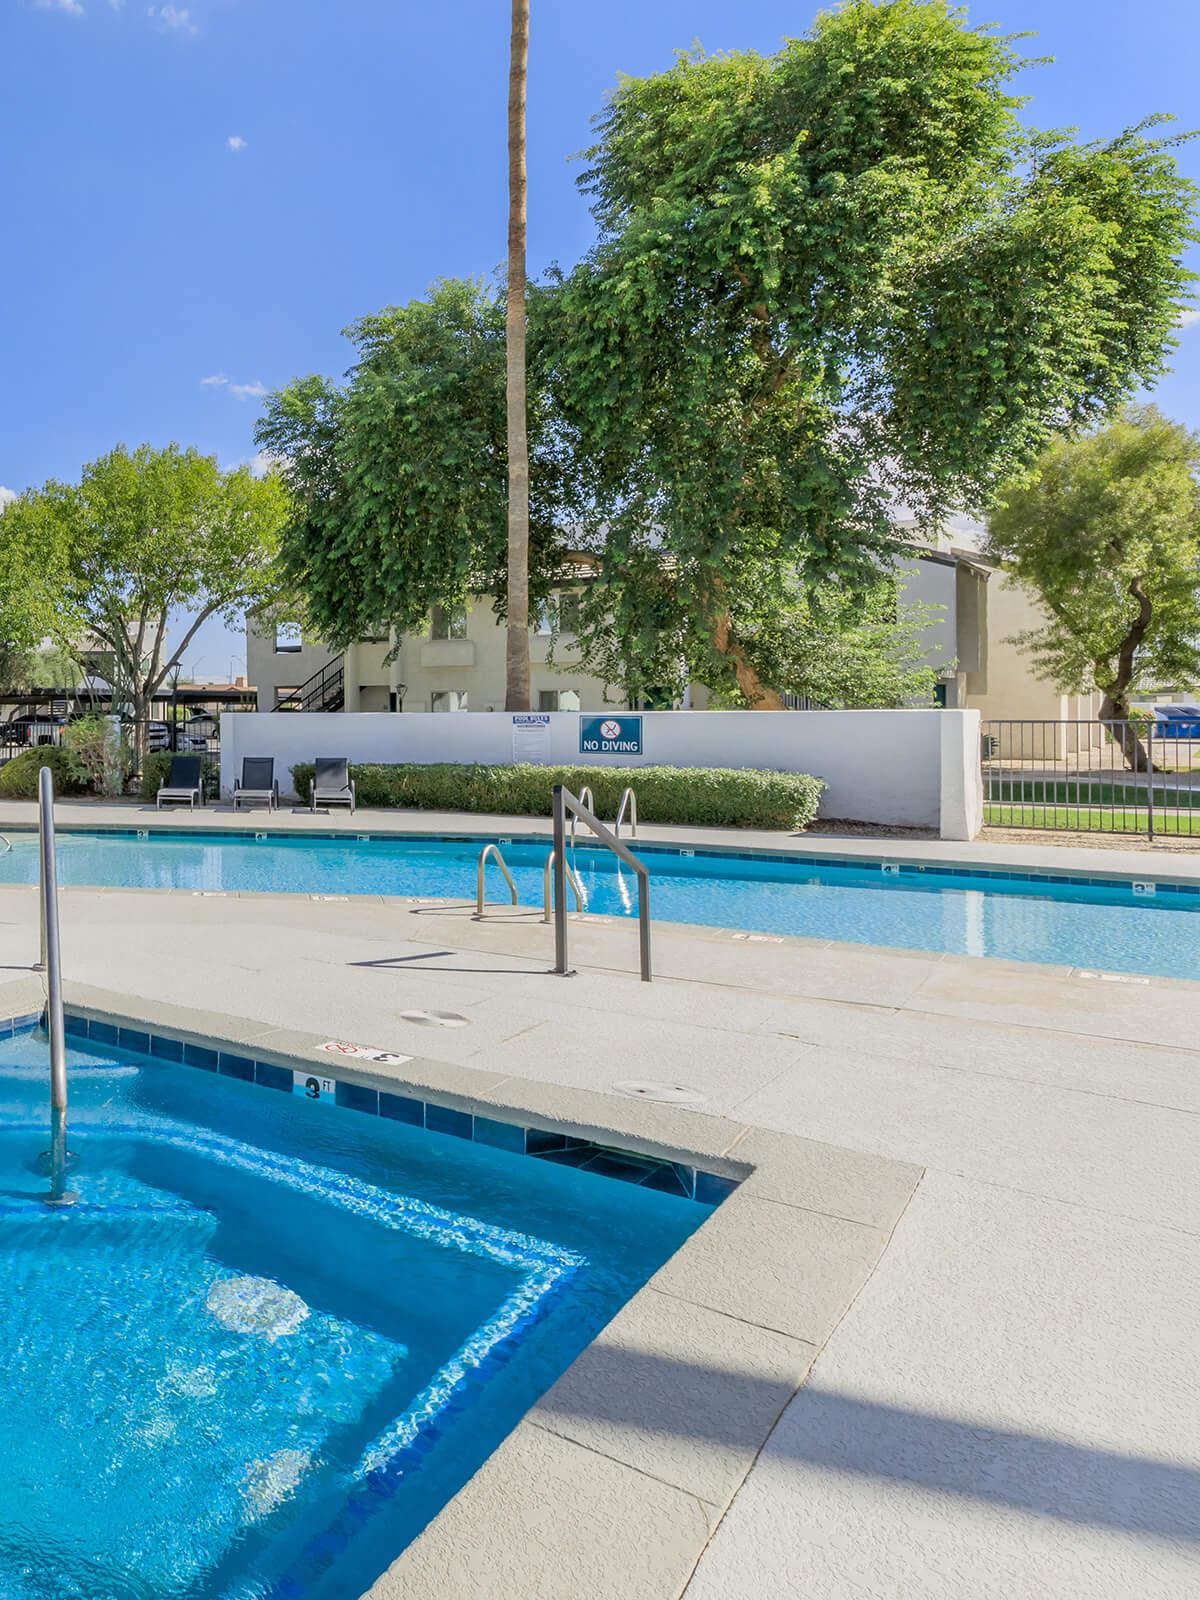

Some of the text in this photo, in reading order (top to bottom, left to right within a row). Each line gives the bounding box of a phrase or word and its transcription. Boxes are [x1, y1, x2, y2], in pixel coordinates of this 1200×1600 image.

[583, 740, 638, 752] NO DIVING
[305, 1077, 331, 1099] 3 FT
